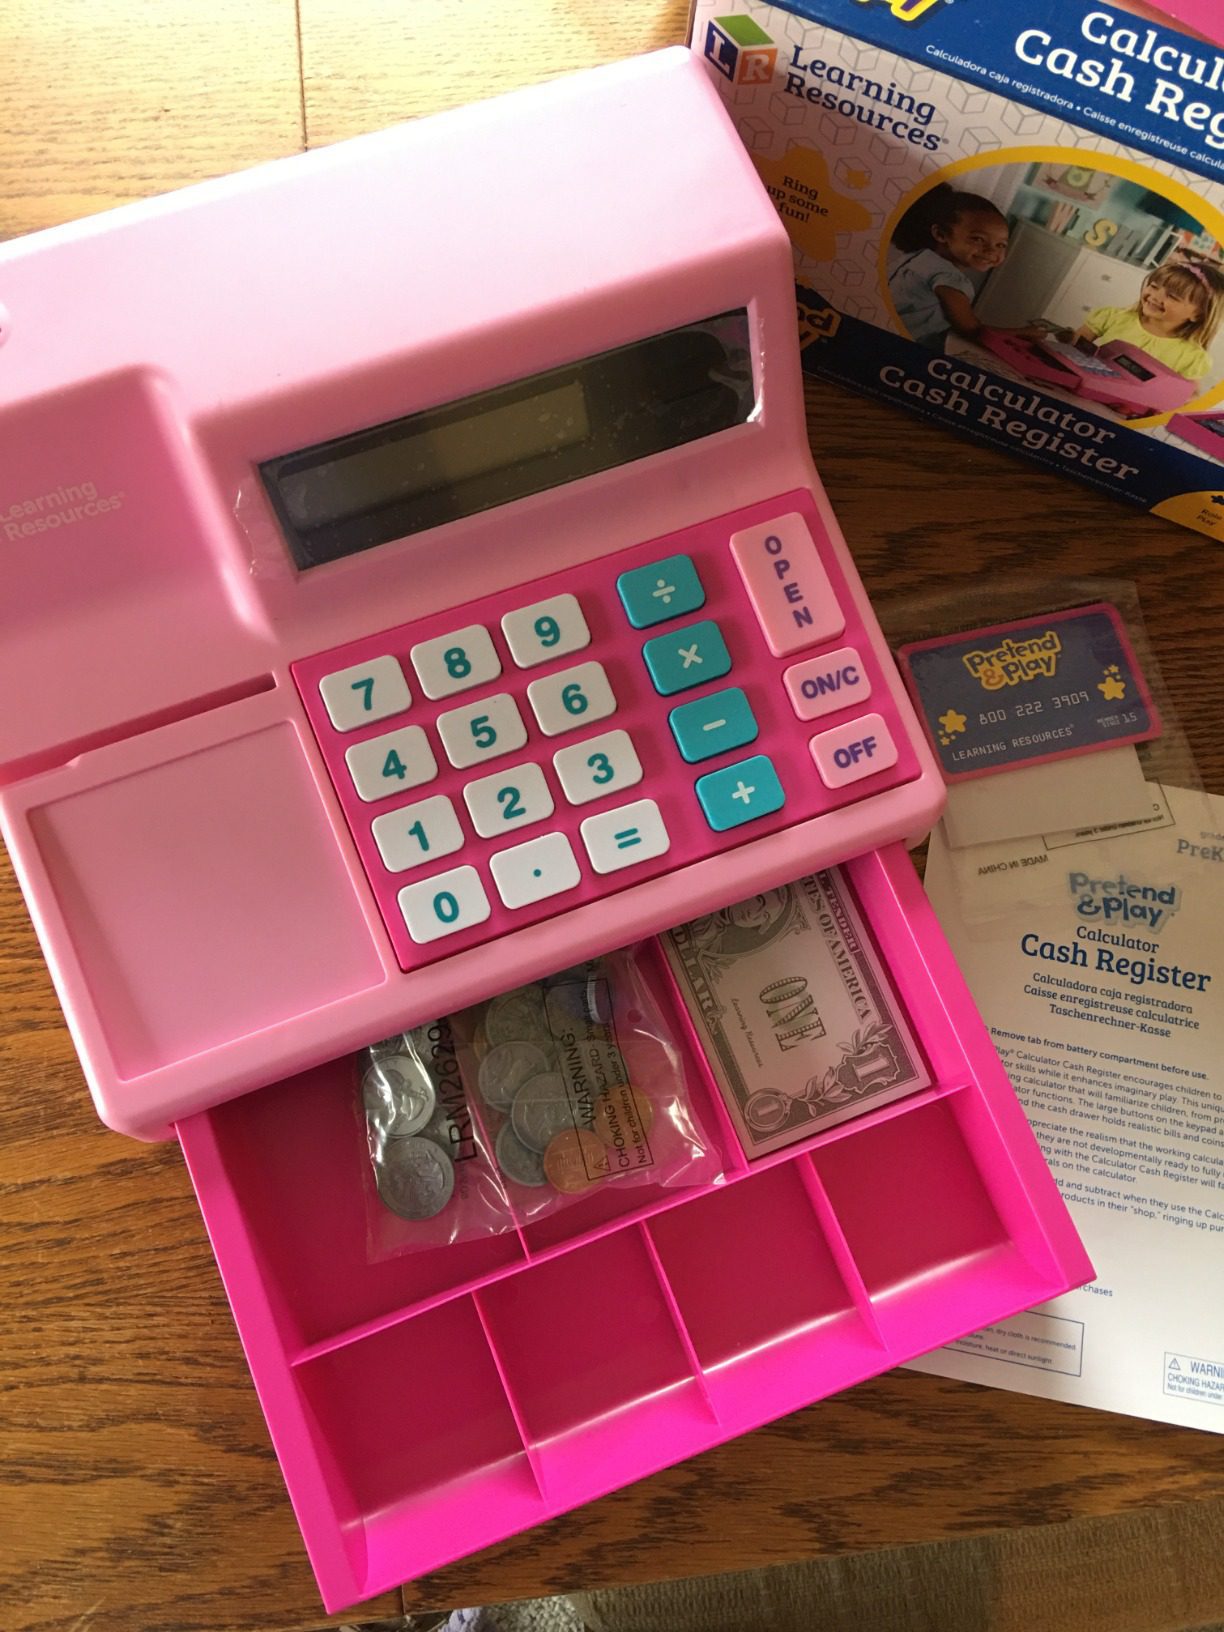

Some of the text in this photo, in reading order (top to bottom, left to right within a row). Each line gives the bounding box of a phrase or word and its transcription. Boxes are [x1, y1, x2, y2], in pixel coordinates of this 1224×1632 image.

[1015, 29, 1135, 103] Cash
[1081, 12, 1224, 92] Calcul
[789, 44, 936, 126] Learning
[925, 44, 987, 75] Calculadora
[989, 70, 1010, 84] caja
[1011, 79, 1074, 110] registradora
[1083, 107, 1117, 127] Caisse
[1118, 122, 1188, 155] enregistreuse
[784, 72, 942, 152] Resources
[766, 185, 828, 217] up some
[783, 175, 818, 201] Ring
[779, 202, 810, 223] fun!
[879, 365, 971, 417] Cash
[978, 403, 1140, 481] Register
[927, 358, 1117, 445] Calculator
[4, 494, 123, 541] Resources
[764, 535, 814, 628] OPEN
[351, 616, 561, 711] 7 8 9
[966, 631, 1059, 674] Pretend
[1002, 654, 1054, 683] Play
[800, 665, 860, 700] ON/C
[978, 691, 1090, 726] 800 222 3909
[382, 683, 589, 780] 4 5 6
[833, 736, 877, 769] OFF
[952, 727, 1073, 762] LEARNING RESOURCES
[409, 752, 615, 852] 1 2 3
[432, 891, 460, 923] 0
[1069, 872, 1176, 905] Pretend
[820, 913, 838, 937] OF
[826, 889, 859, 951] TENDER
[1102, 897, 1163, 928] Play
[1076, 926, 1160, 954] Calculator
[827, 938, 873, 1020] AMERICA
[1021, 933, 1212, 992] Cash Register
[759, 975, 827, 1052] ONE
[1024, 984, 1200, 1030] Caisse enregistreuse calculatrice
[1032, 972, 1193, 1015] Calculadora caja registradora
[1049, 1003, 1172, 1038] Taschenrechner-Kasse
[990, 1027, 1206, 1079] Remove tab from battery compartment before use.
[561, 1027, 597, 1126] WARNING:
[1015, 1062, 1036, 1073] skills
[1038, 1068, 1061, 1078] while
[1070, 1075, 1112, 1089] enhances
[1114, 1084, 1157, 1100] imaginary
[1182, 1096, 1199, 1107] This
[1016, 1050, 1222, 1101] Calculator Cash Register encourages children to
[590, 1049, 630, 1168] CHOKING HAZARD
[1022, 1076, 1066, 1090] calculator
[1068, 1085, 1085, 1094] that
[1087, 1090, 1102, 1098] will
[1104, 1092, 1149, 1108] familiarize
[1191, 1110, 1211, 1121] from
[1078, 1097, 1094, 1108] The
[1096, 1102, 1118, 1114] large
[1120, 1106, 1154, 1121] buttons
[1169, 1118, 1184, 1127] the
[1186, 1121, 1217, 1134] keypad
[633, 1136, 642, 1149] for
[1031, 1100, 1045, 1109] the
[1047, 1105, 1067, 1114] cash
[1069, 1108, 1099, 1120] drawer
[1102, 1114, 1126, 1127] holds
[1127, 1122, 1161, 1134] realistic
[1163, 1128, 1181, 1138] bills
[1183, 1133, 1199, 1142] and
[637, 1151, 647, 1164] Not
[1036, 1131, 1221, 1178] they are not developmentally ready to fully
[1069, 1127, 1191, 1160] the realism that the working
[1054, 1148, 1215, 1188] with the Calculator Cash Register will
[1062, 1161, 1074, 1170] on
[1076, 1163, 1090, 1173] the
[1065, 1182, 1202, 1216] and subtract when they use the
[1107, 1201, 1128, 1212] their
[1162, 1213, 1193, 1228] ringing
[1195, 1221, 1207, 1230] up
[1167, 1372, 1200, 1387] CHOKING
